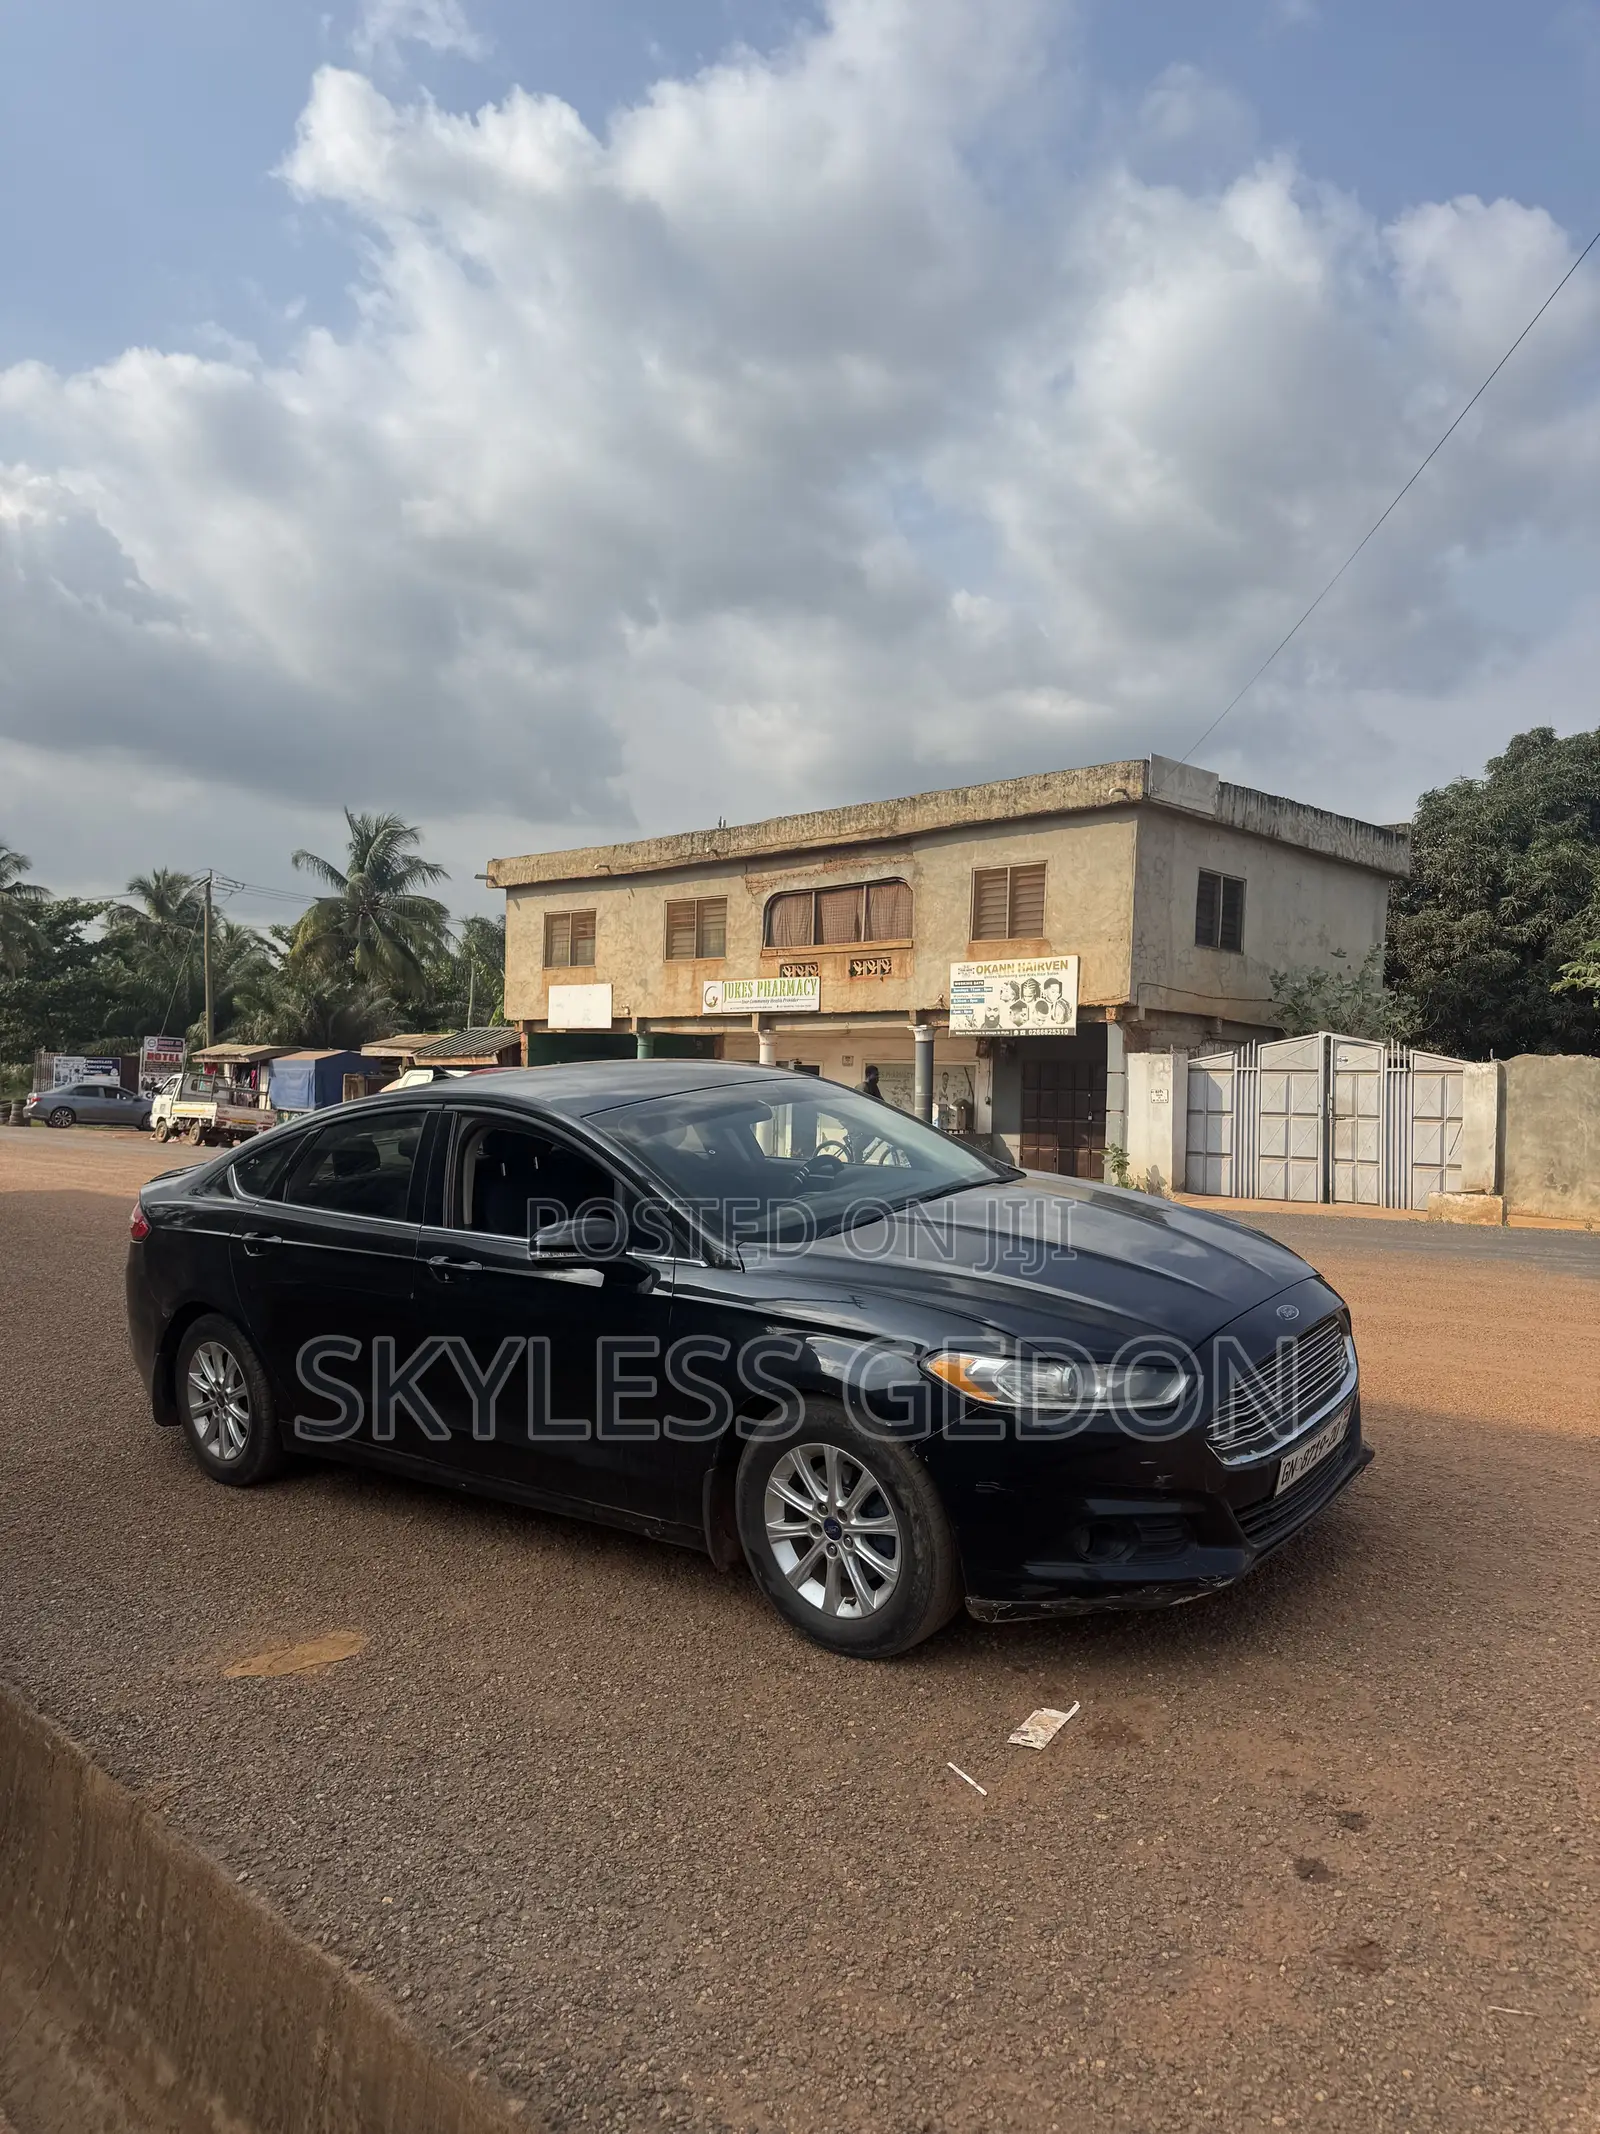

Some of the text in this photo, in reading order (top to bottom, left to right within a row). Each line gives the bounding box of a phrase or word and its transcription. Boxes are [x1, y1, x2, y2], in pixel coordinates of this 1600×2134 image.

[975, 963, 1015, 975] OKANN
[1017, 959, 1069, 973] HAIRVEN
[723, 978, 818, 1003] JUKES PHARMACY
[1281, 1456, 1299, 1485] GN
